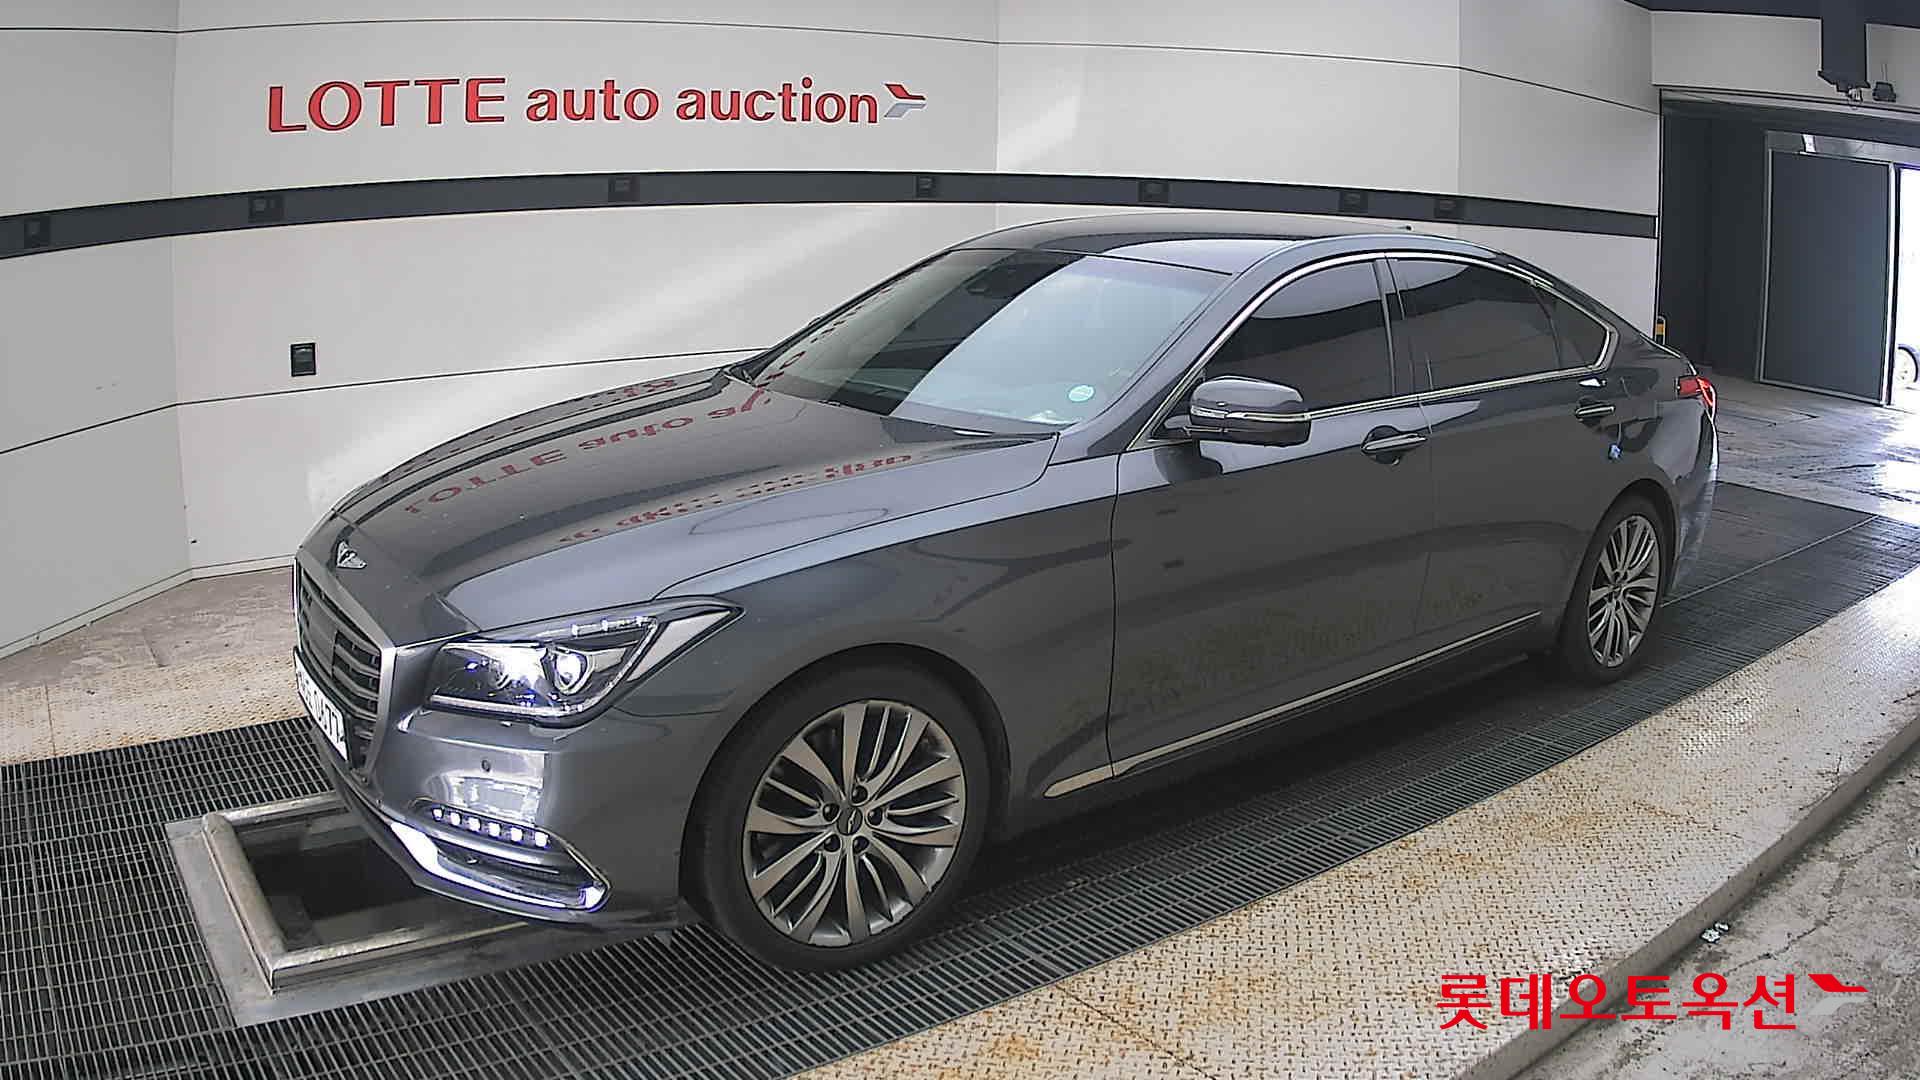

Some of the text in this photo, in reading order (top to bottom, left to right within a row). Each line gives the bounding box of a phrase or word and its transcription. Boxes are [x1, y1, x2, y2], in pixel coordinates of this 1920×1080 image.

[268, 77, 879, 132] LOTTE auto auction
